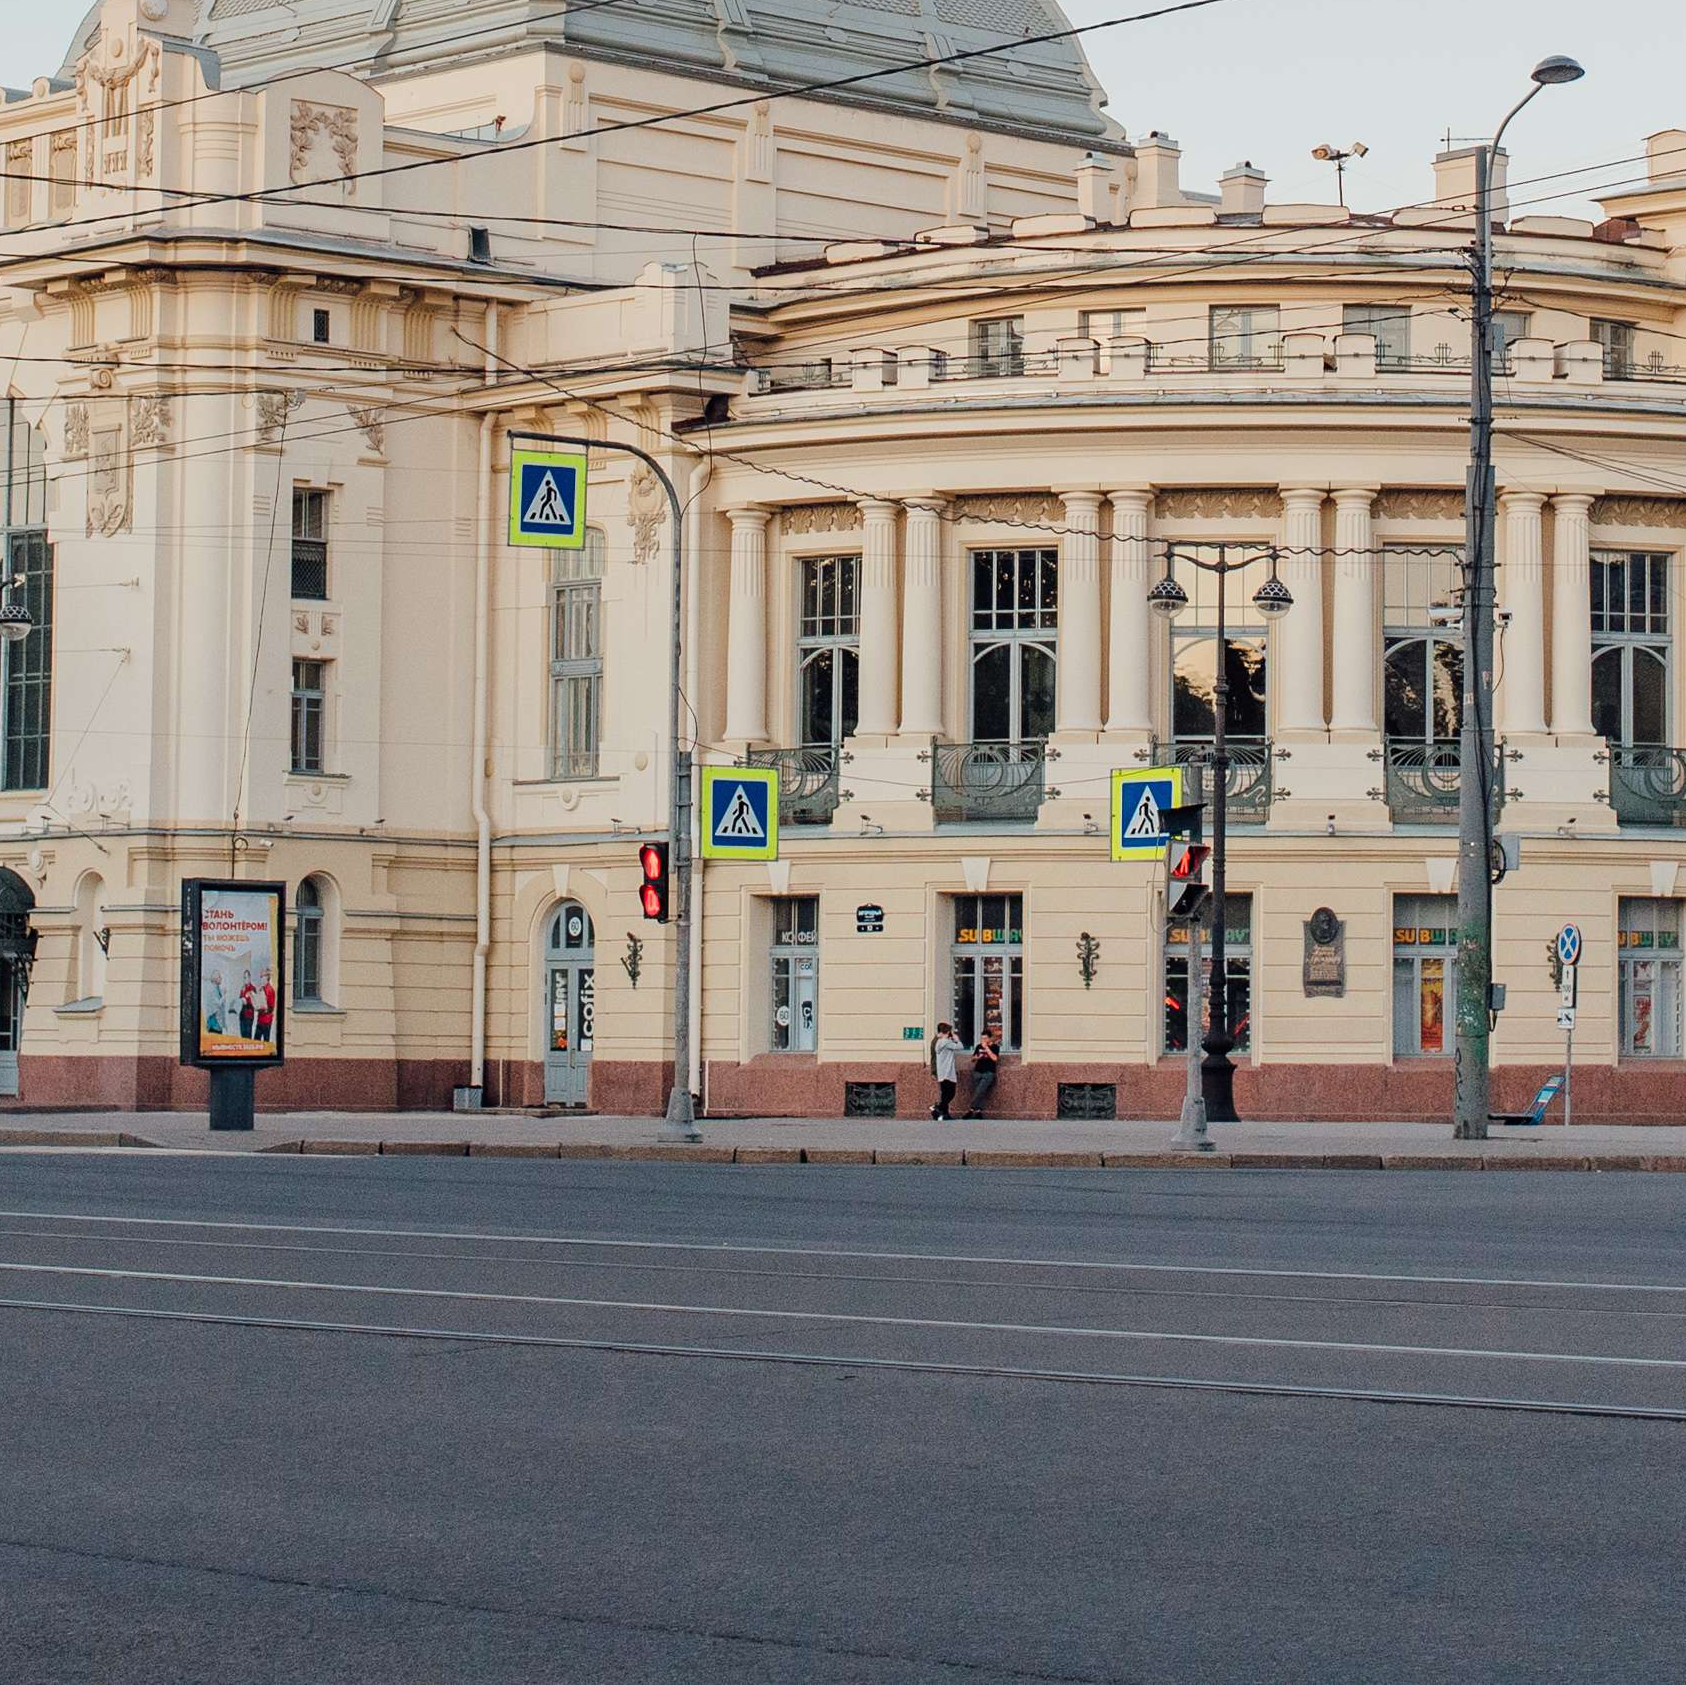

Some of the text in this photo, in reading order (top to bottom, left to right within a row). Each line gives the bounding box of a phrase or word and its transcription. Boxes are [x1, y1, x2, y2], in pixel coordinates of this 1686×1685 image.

[958, 928, 1022, 942] SUBWA
[1395, 929, 1457, 942] SUBWA
[580, 974, 595, 1037] cofix
